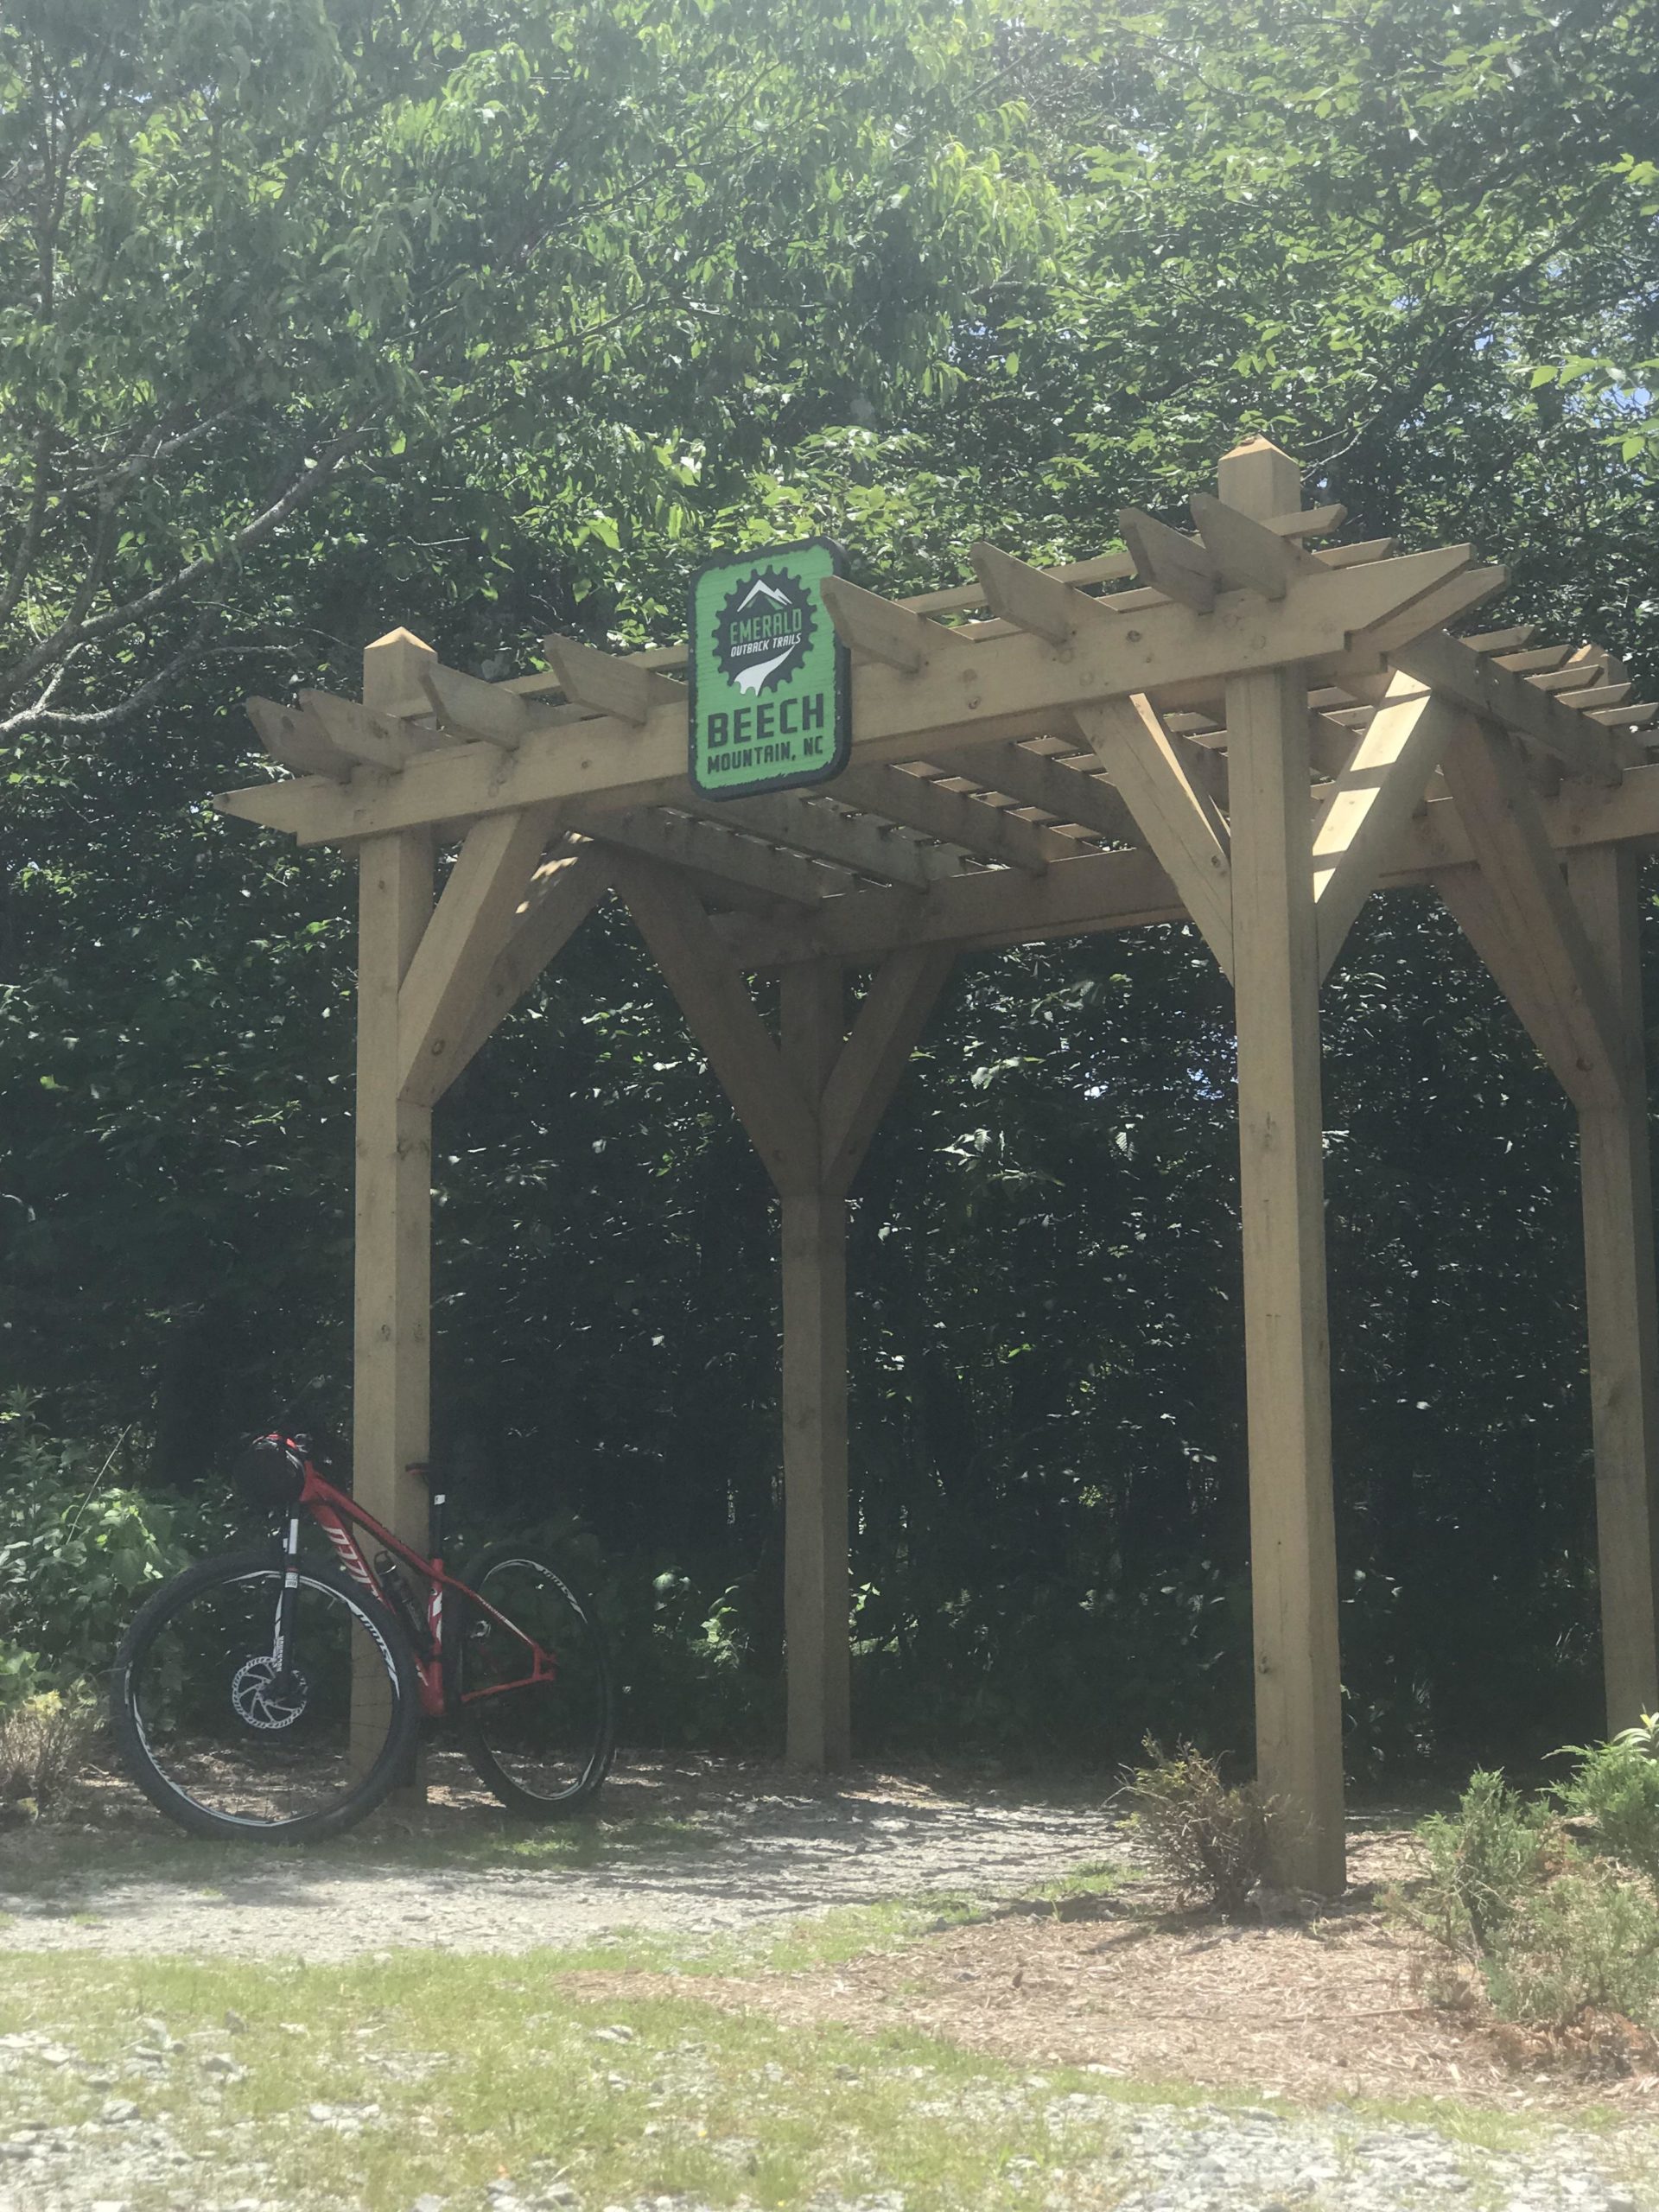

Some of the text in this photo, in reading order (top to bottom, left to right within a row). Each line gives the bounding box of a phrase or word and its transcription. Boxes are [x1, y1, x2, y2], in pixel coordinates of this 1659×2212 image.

[730, 608, 802, 645] EMERALD
[730, 632, 802, 658] OUTBACK TRAILS
[708, 693, 823, 749] BEECH
[708, 735, 823, 775] MOUNTAIN, NC
